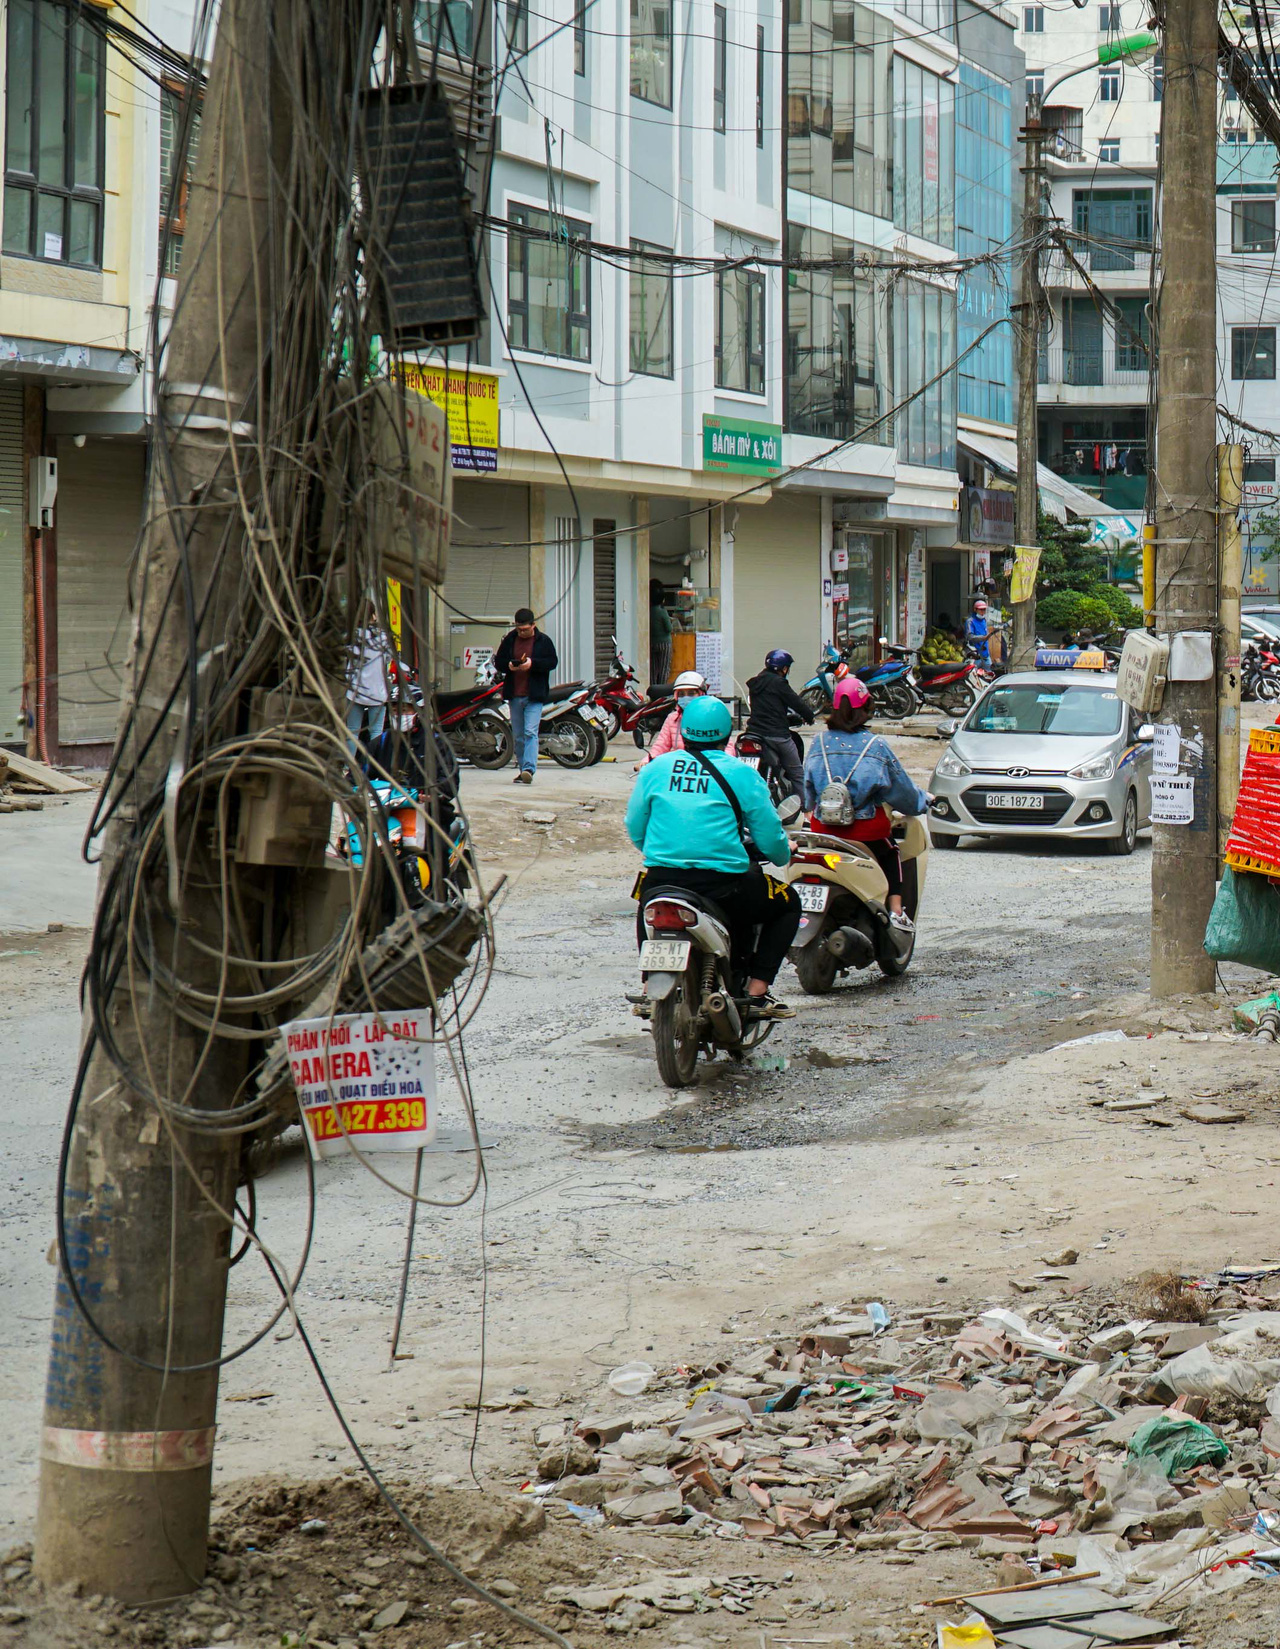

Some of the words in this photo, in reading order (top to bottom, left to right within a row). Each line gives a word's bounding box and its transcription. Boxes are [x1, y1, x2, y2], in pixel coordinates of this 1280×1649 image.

[686, 727, 720, 737] BAEMIN
[669, 776, 710, 794] MIN
[643, 955, 685, 969] 369.37
[290, 1051, 372, 1087] CAMERA
